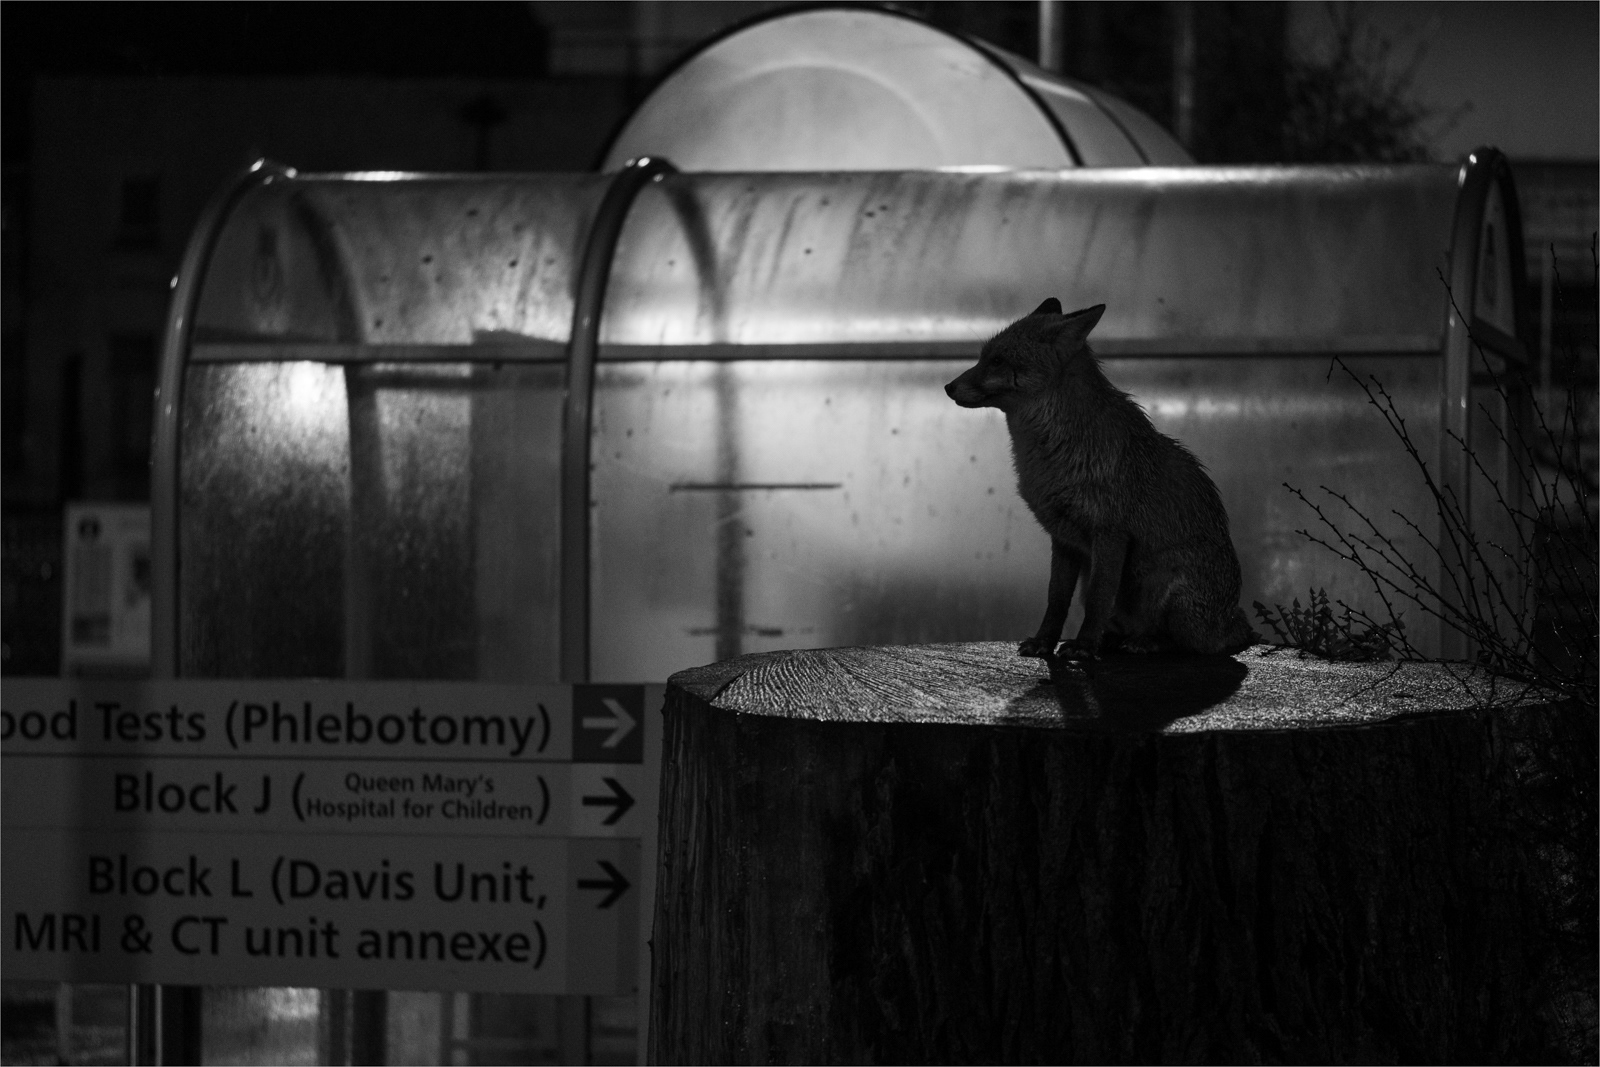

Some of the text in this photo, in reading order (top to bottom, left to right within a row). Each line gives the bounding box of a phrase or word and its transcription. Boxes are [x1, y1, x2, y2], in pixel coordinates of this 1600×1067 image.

[96, 704, 205, 741] Tests
[226, 701, 550, 757] (Phlebotomy)
[116, 772, 237, 813] Block
[254, 776, 270, 814] J
[307, 797, 532, 821] Hospital for Children
[345, 773, 494, 798] Queen Mary's
[90, 855, 546, 909] Block L (Davis Unit,
[16, 913, 546, 969] MRI & CT unit annexe)
